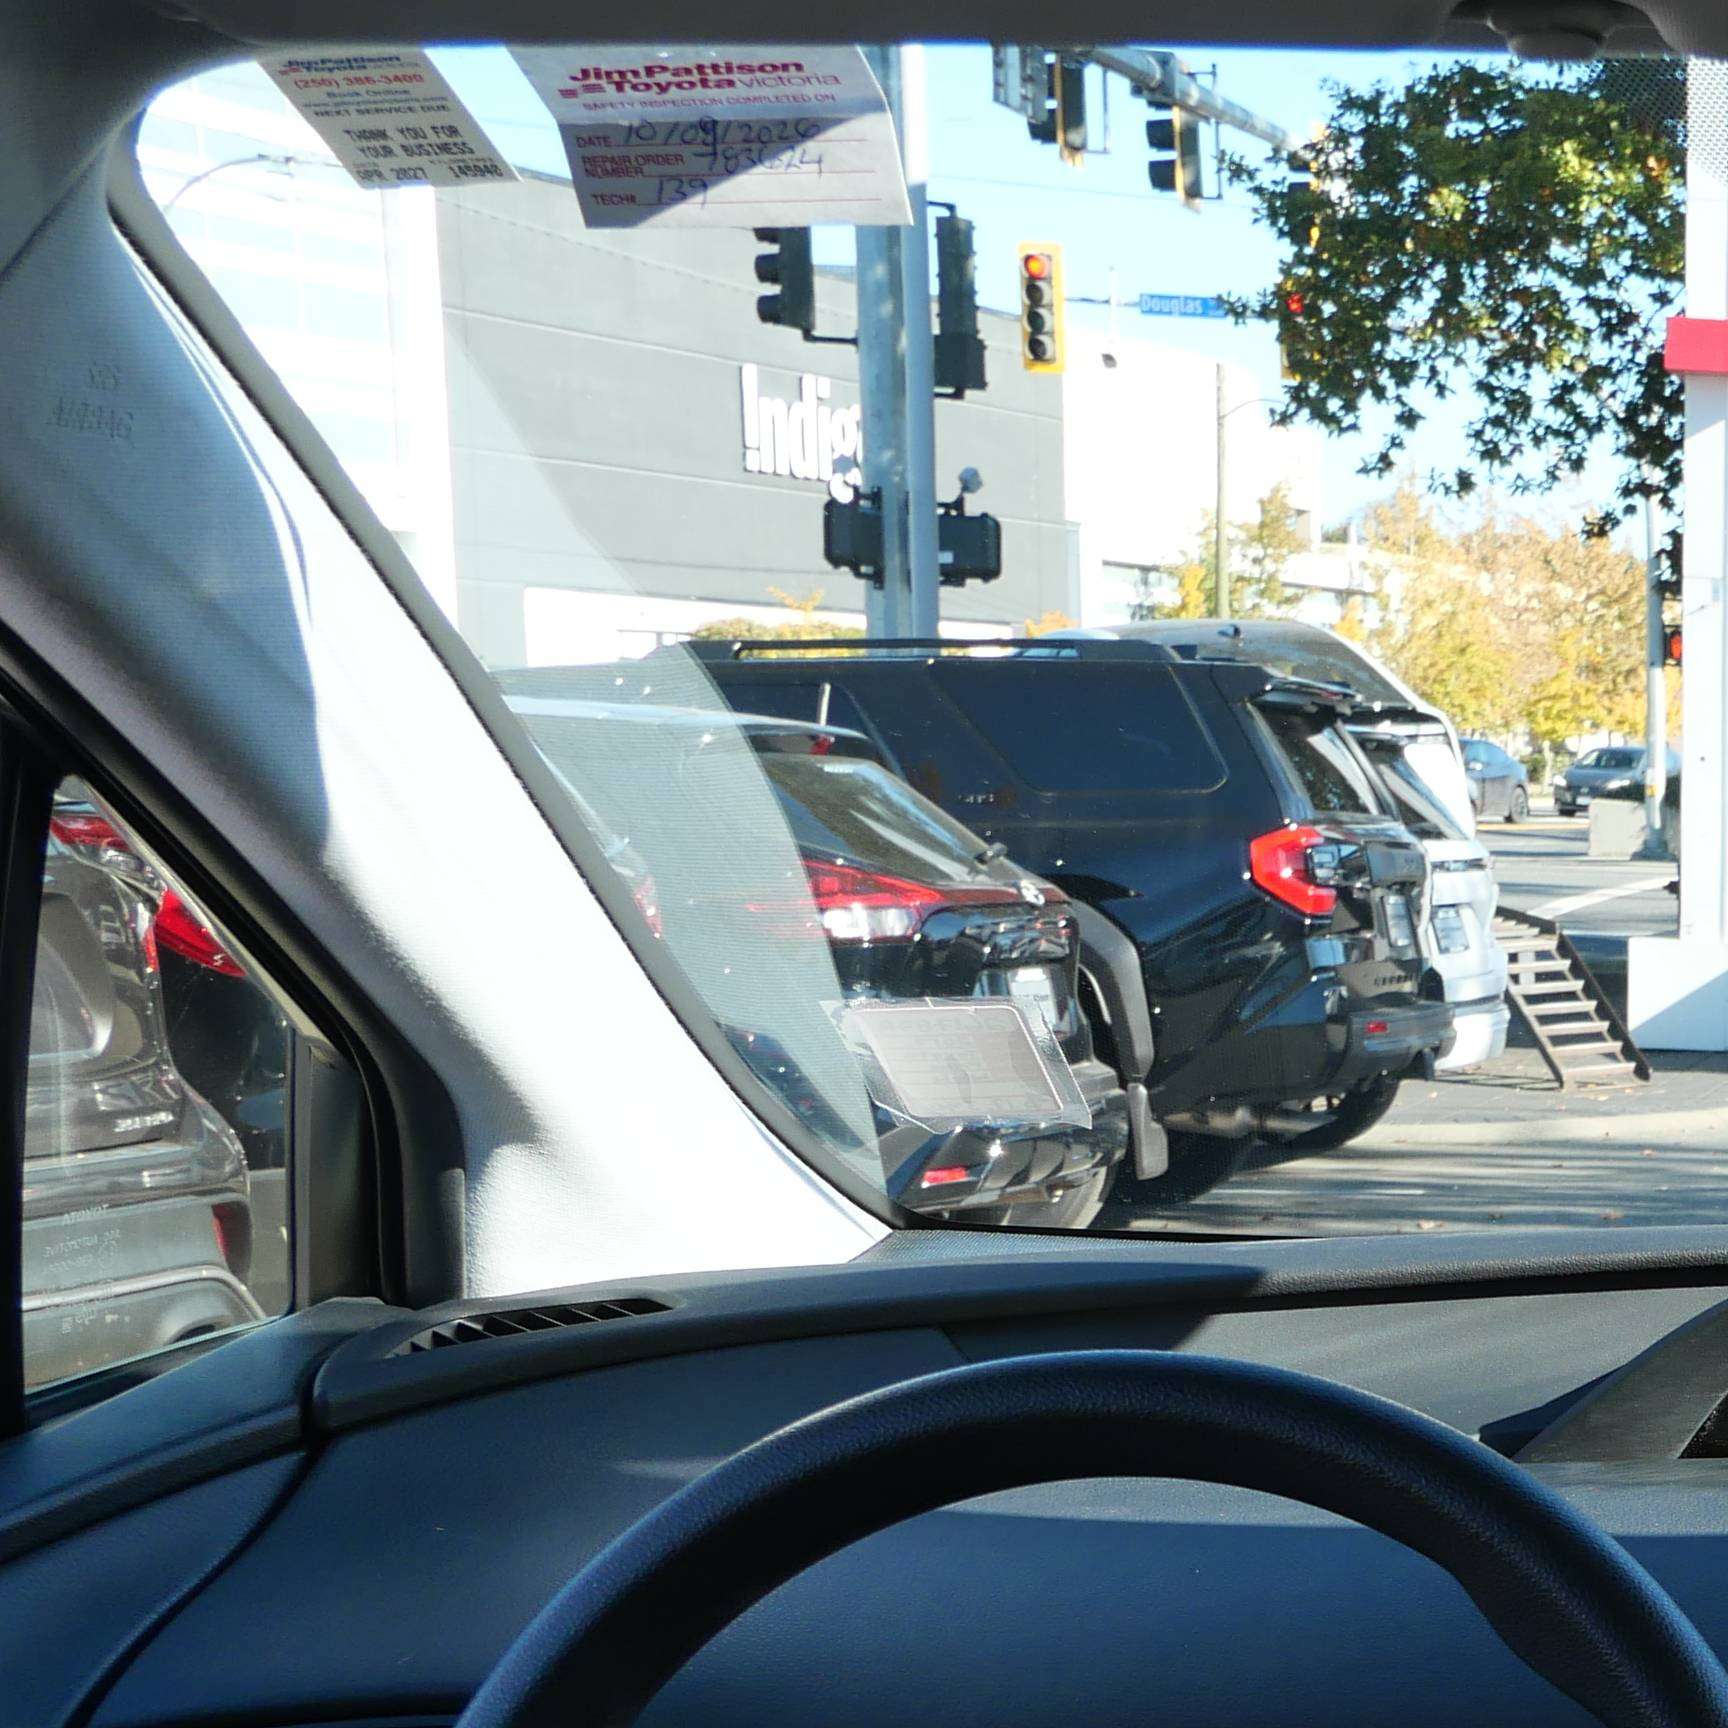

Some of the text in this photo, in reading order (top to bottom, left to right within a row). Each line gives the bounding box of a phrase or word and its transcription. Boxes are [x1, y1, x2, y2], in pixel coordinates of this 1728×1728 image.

[294, 77, 341, 90] (250)
[606, 77, 737, 95] Toyota
[582, 92, 838, 111] SAFETY INSPECTION COMPLETED ON
[314, 104, 450, 117] NEXT SERVICE DUE
[342, 124, 463, 142] THANK YOU FOR
[357, 141, 476, 159] YOUR BUSINESS
[576, 134, 613, 150] DATE
[582, 153, 686, 168] REPAIR ORDER
[583, 166, 644, 178] NUMBER
[1141, 294, 1203, 318] Douglas
